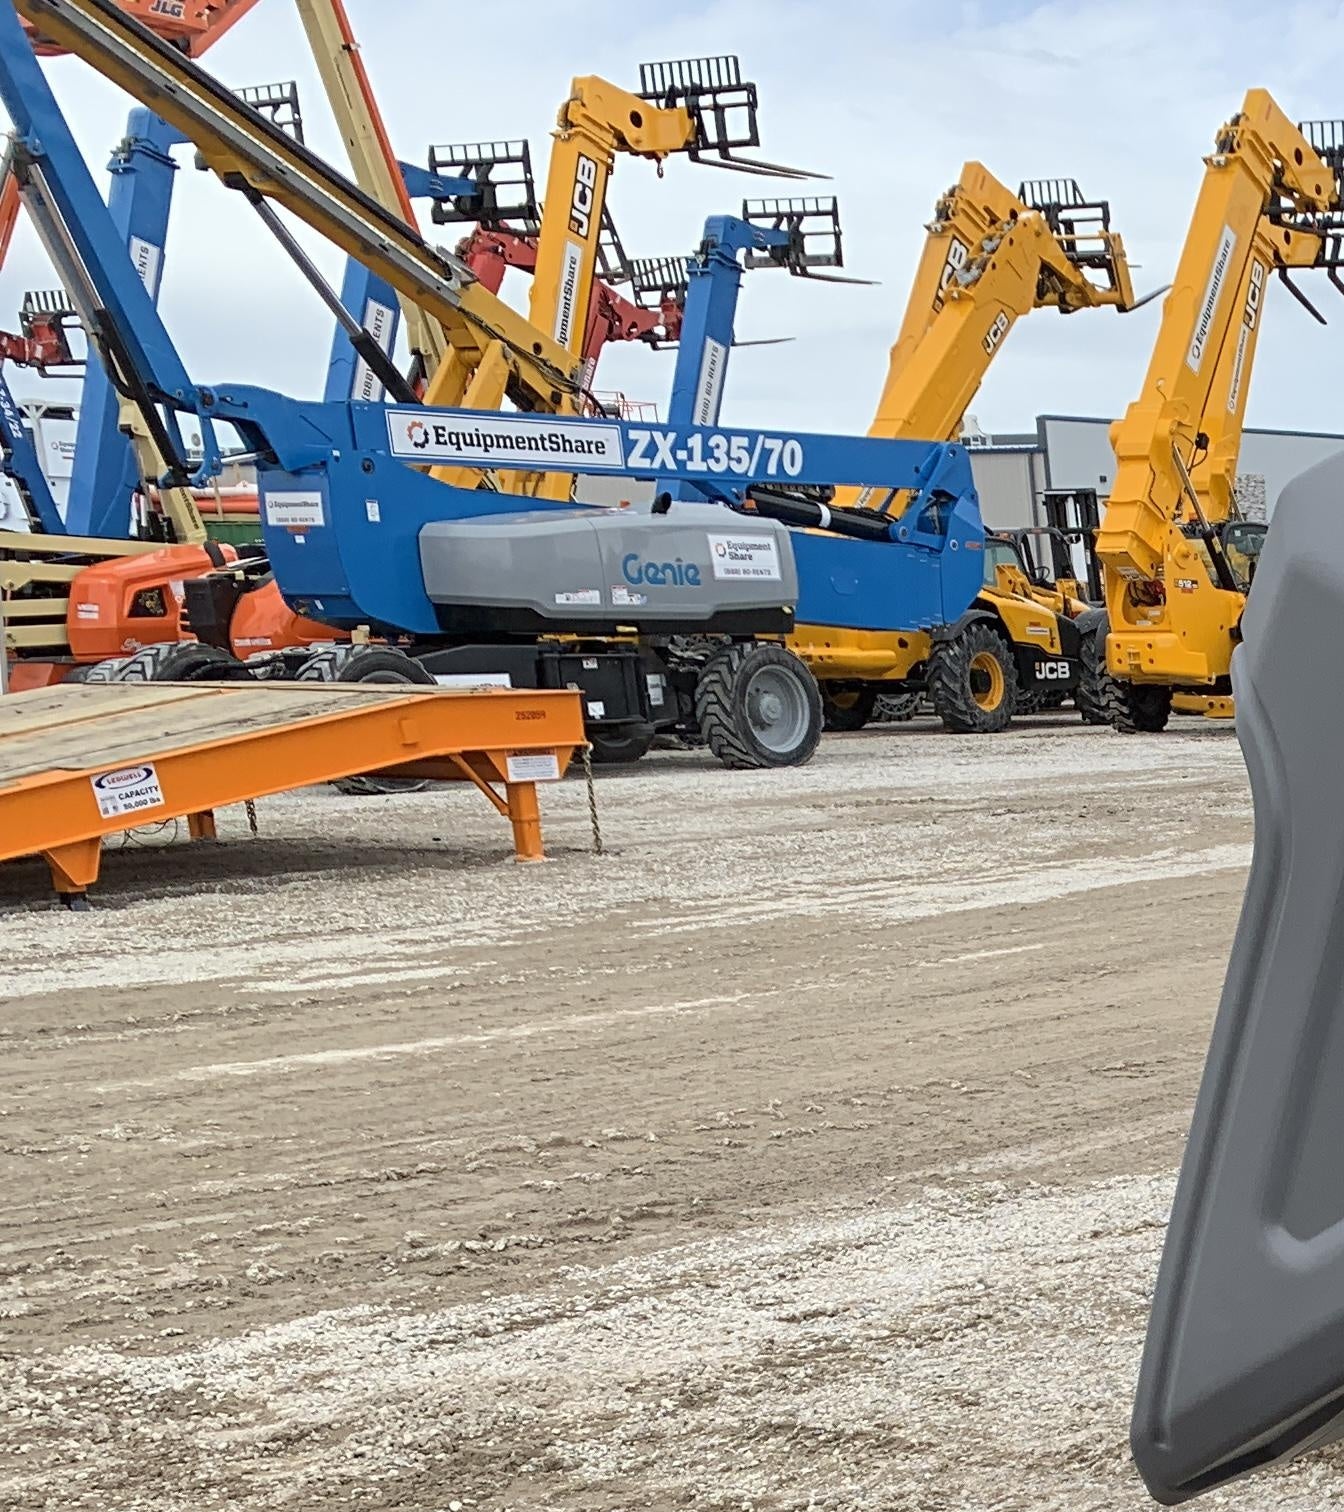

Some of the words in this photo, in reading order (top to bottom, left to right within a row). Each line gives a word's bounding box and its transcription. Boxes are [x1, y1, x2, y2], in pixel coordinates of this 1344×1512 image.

[572, 156, 597, 238] JCB
[1197, 239, 1231, 347] EquipmentShare
[1246, 261, 1264, 331] JCB
[985, 310, 1009, 355] JCB
[433, 425, 607, 456] EquipmentShare
[627, 429, 804, 477] ZX-135/70
[621, 552, 701, 586] Genie
[726, 540, 772, 555] Equipment
[728, 551, 753, 562] Share
[118, 785, 159, 800] CAPACITY
